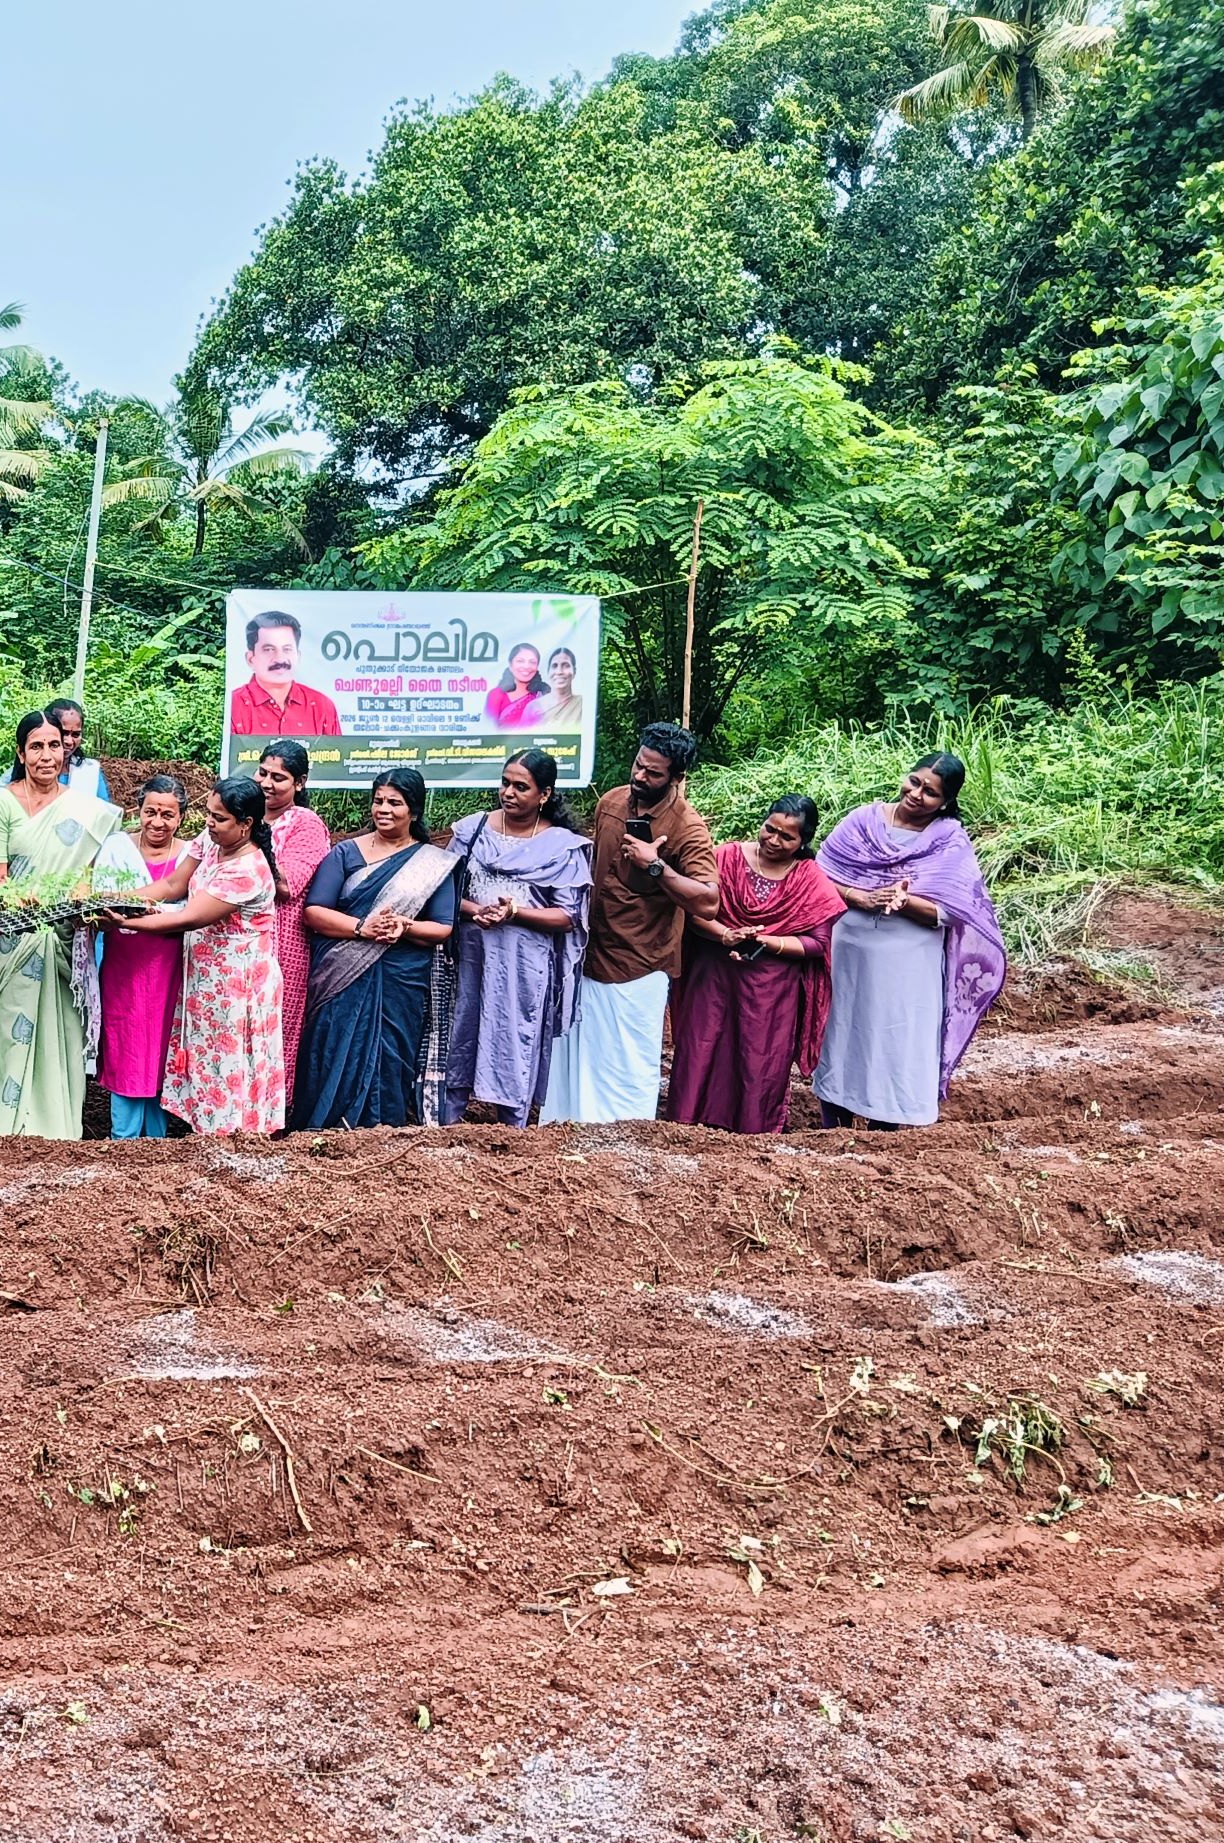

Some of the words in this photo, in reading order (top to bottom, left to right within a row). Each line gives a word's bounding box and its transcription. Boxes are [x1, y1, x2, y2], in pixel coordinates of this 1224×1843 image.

[321, 618, 499, 662] പൊലിമ
[334, 675, 403, 696] ചെണ്ടുമല്ലി
[408, 678, 442, 692] തൈ
[448, 676, 487, 692] നടീൽ
